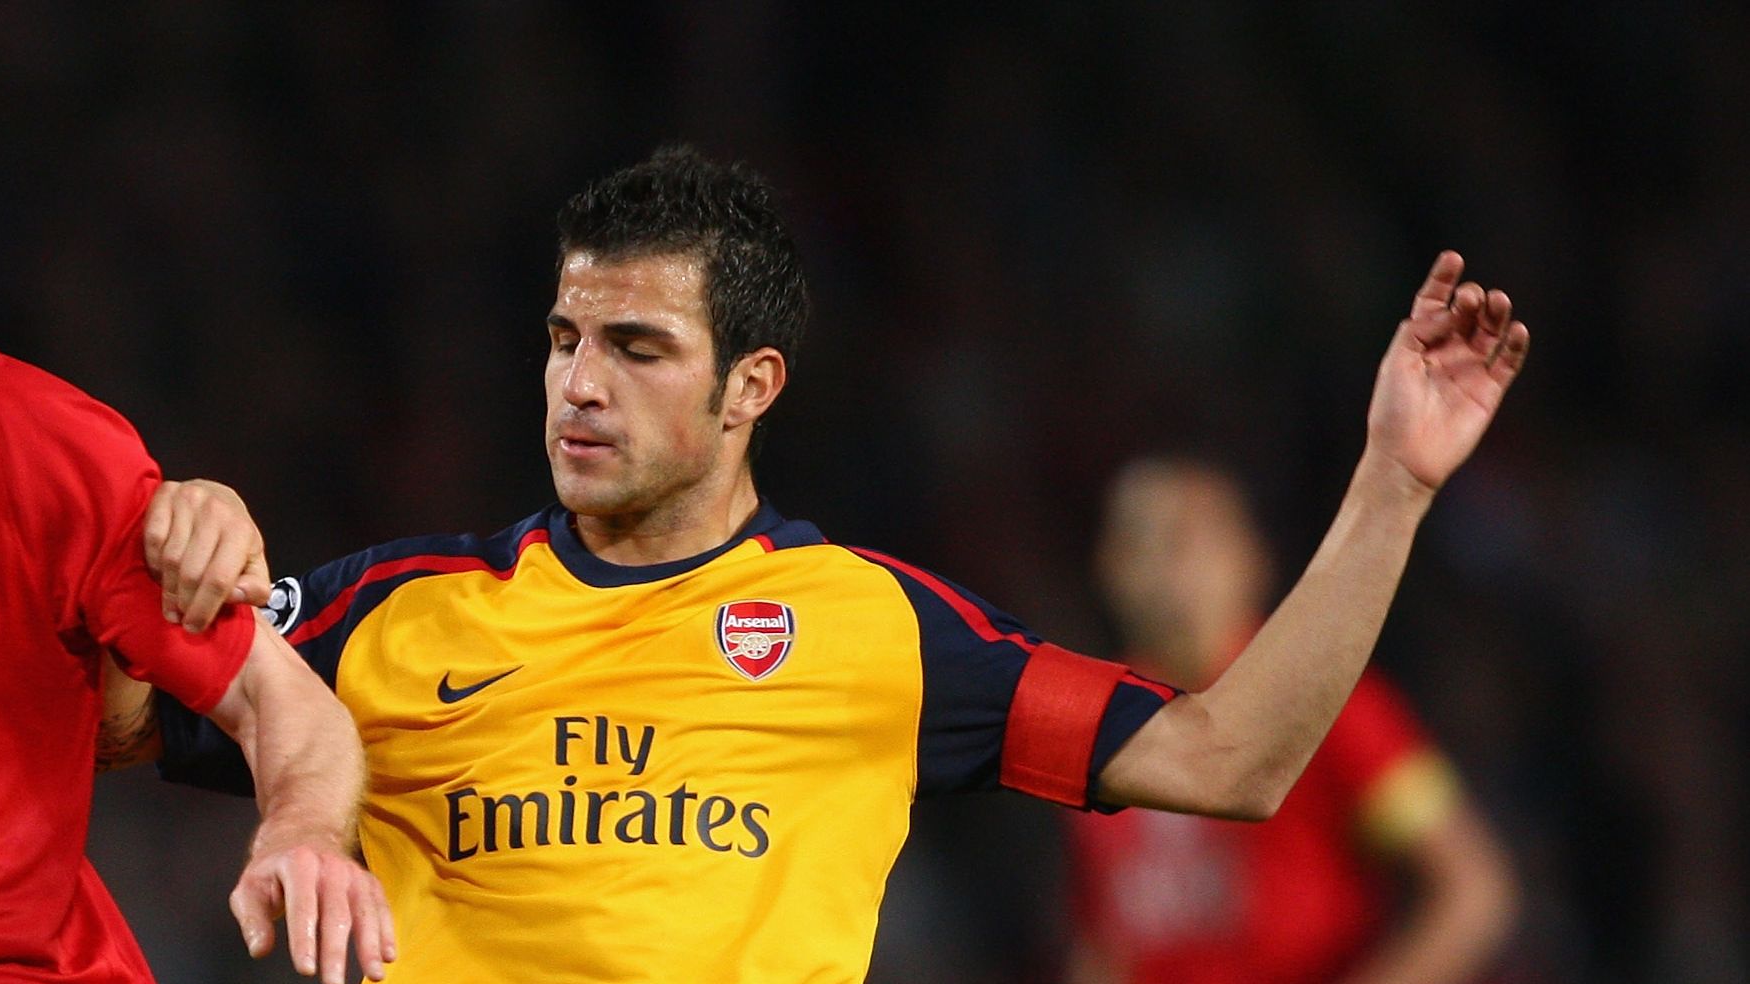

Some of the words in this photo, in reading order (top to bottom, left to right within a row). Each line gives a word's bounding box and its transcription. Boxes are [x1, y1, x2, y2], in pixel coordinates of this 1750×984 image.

[726, 614, 784, 628] Arsenal
[554, 715, 655, 775] Fly
[444, 775, 770, 862] Emirates
